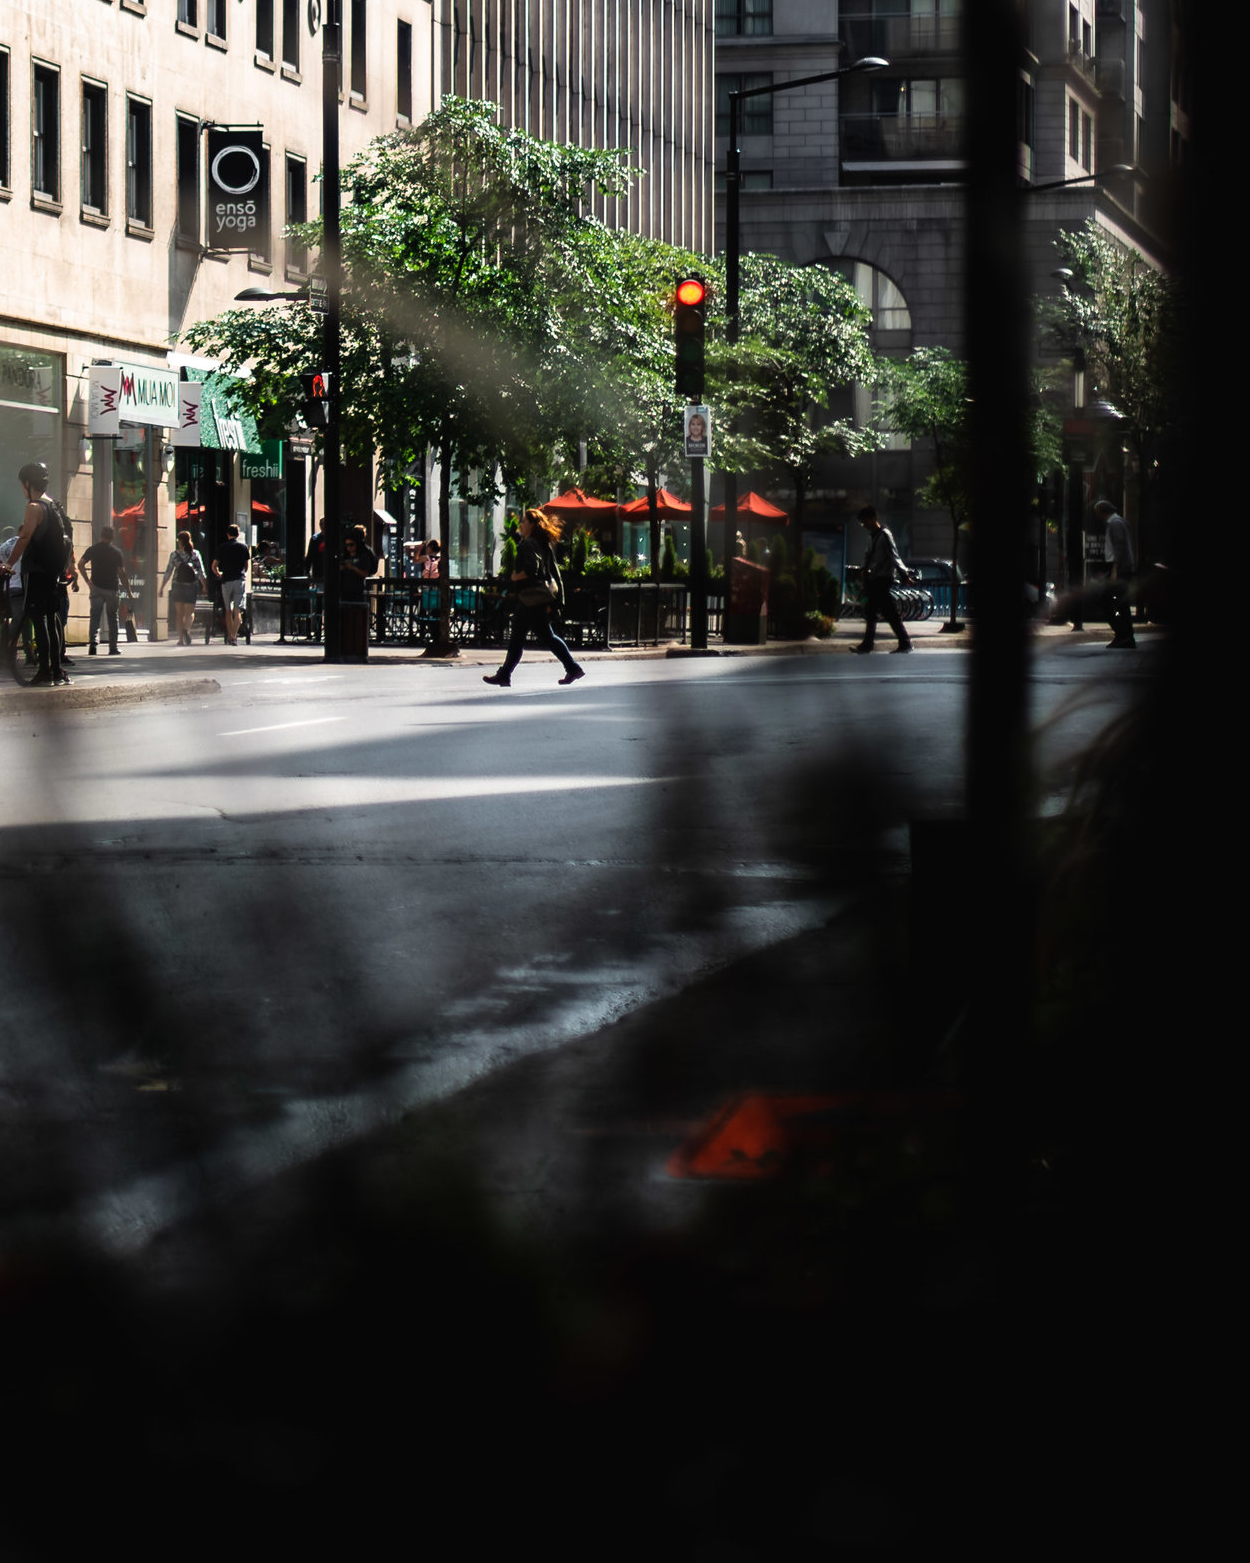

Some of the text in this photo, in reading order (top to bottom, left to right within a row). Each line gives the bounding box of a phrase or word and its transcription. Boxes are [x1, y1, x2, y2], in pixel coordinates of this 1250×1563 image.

[216, 215, 256, 233] yoga
[137, 378, 157, 406] MUA
[242, 458, 279, 478] freshii
